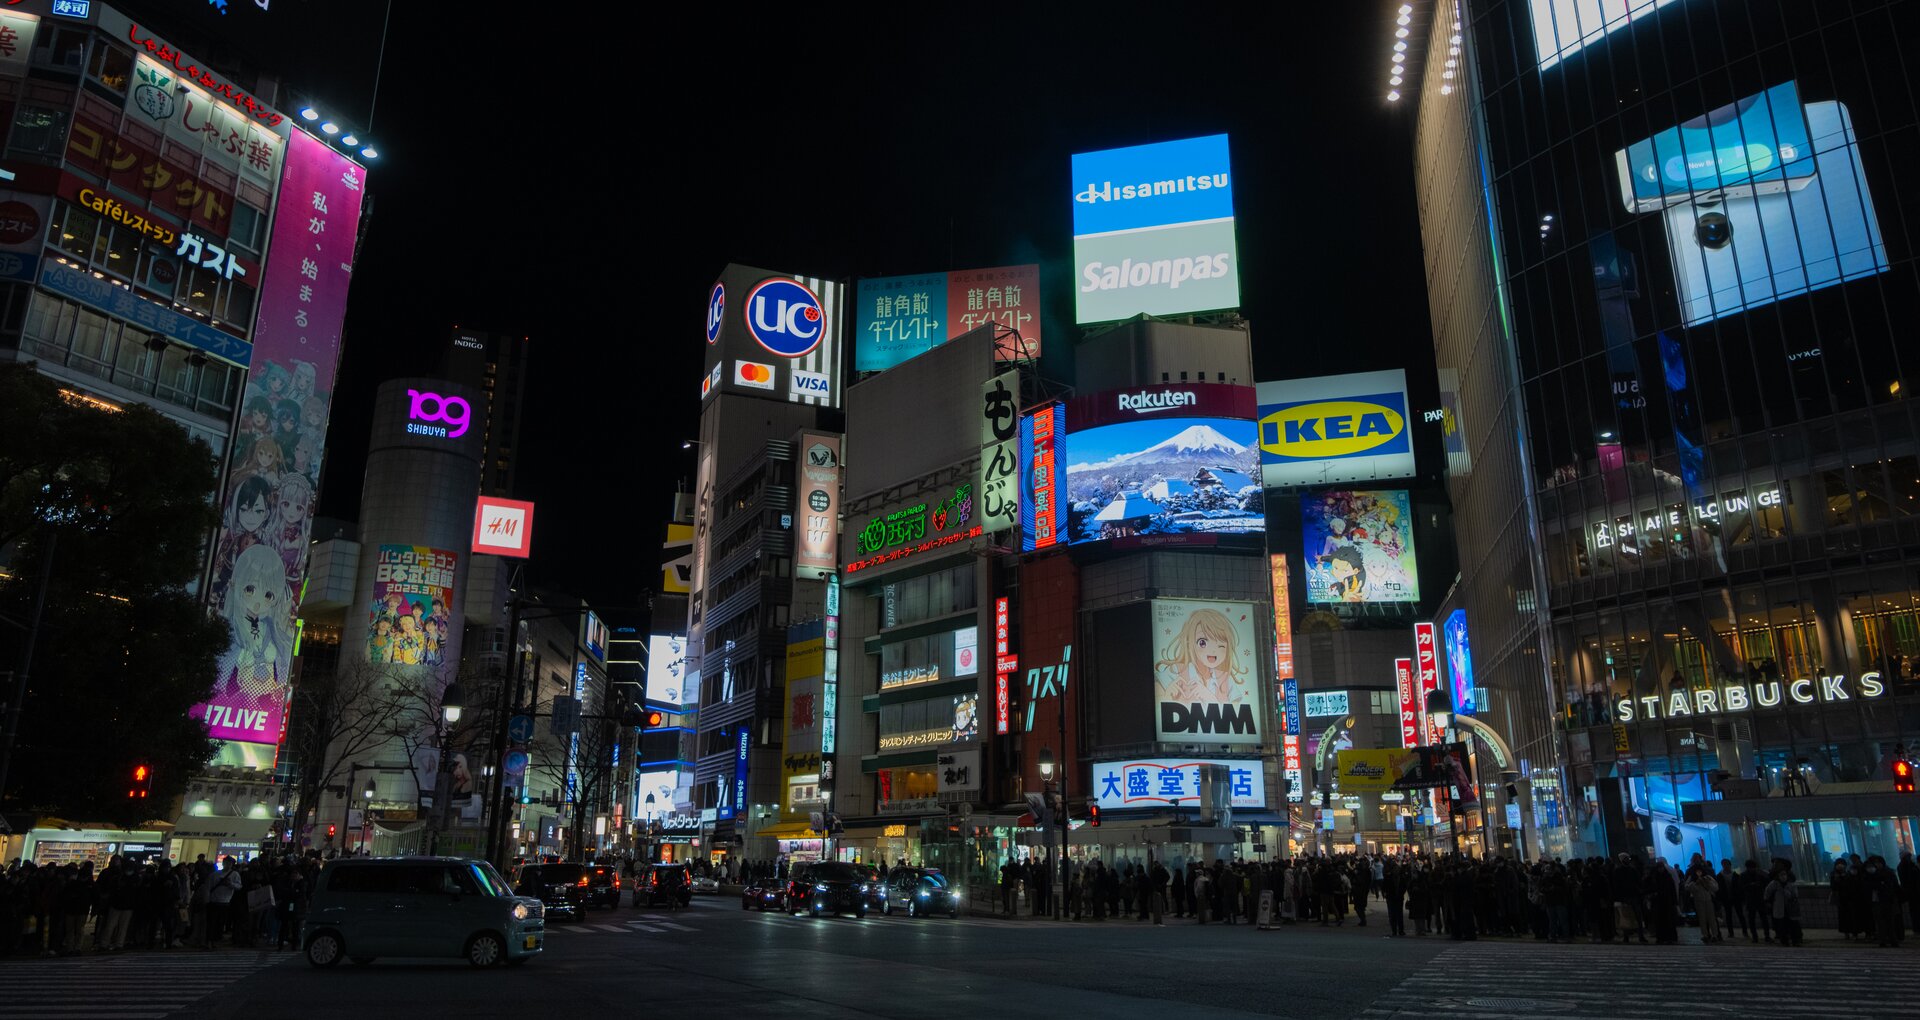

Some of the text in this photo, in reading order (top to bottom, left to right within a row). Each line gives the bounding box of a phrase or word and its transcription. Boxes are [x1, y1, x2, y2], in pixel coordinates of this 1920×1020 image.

[56, 0, 87, 15] 寿司
[129, 24, 285, 127] しゃぶしゃぶバイキング
[183, 100, 272, 172] しゃぶ葉
[69, 120, 226, 222] コンタクト
[1075, 173, 1228, 204] Hisamitsu
[79, 187, 247, 281] Caféレストラン ガスト
[294, 190, 329, 345] 私が、始まる。
[1081, 252, 1229, 293] Salonpas
[52, 270, 106, 300] AEON
[967, 284, 1022, 311] 龍角散
[755, 295, 818, 339] UC
[875, 291, 929, 319] 龍角散
[867, 316, 939, 343] ダイレクト
[453, 339, 484, 351] INDIGO
[795, 375, 828, 392] VISA
[407, 388, 472, 438] 109
[1118, 390, 1197, 411] Rakuten
[407, 422, 446, 438] SHIBUYA
[1263, 412, 1394, 445] IKEA
[984, 379, 1018, 524] もんじゃ
[1034, 410, 1055, 540] 三千里薬品
[488, 516, 518, 538] H&M
[886, 513, 926, 547] 西村
[376, 563, 455, 589] 日本武道館
[1309, 568, 1330, 583] 2.5
[1273, 556, 1290, 637] クスリのことなら
[1399, 668, 1407, 683] BIG
[1316, 693, 1347, 705] れいわ
[1401, 683, 1410, 704] ECHO
[1618, 671, 1885, 723] STARBUCKS
[204, 704, 269, 731] 17LIVE
[1161, 701, 1256, 734] DMM
[1307, 704, 1348, 716] クリニック
[740, 732, 748, 760] MIZUHO
